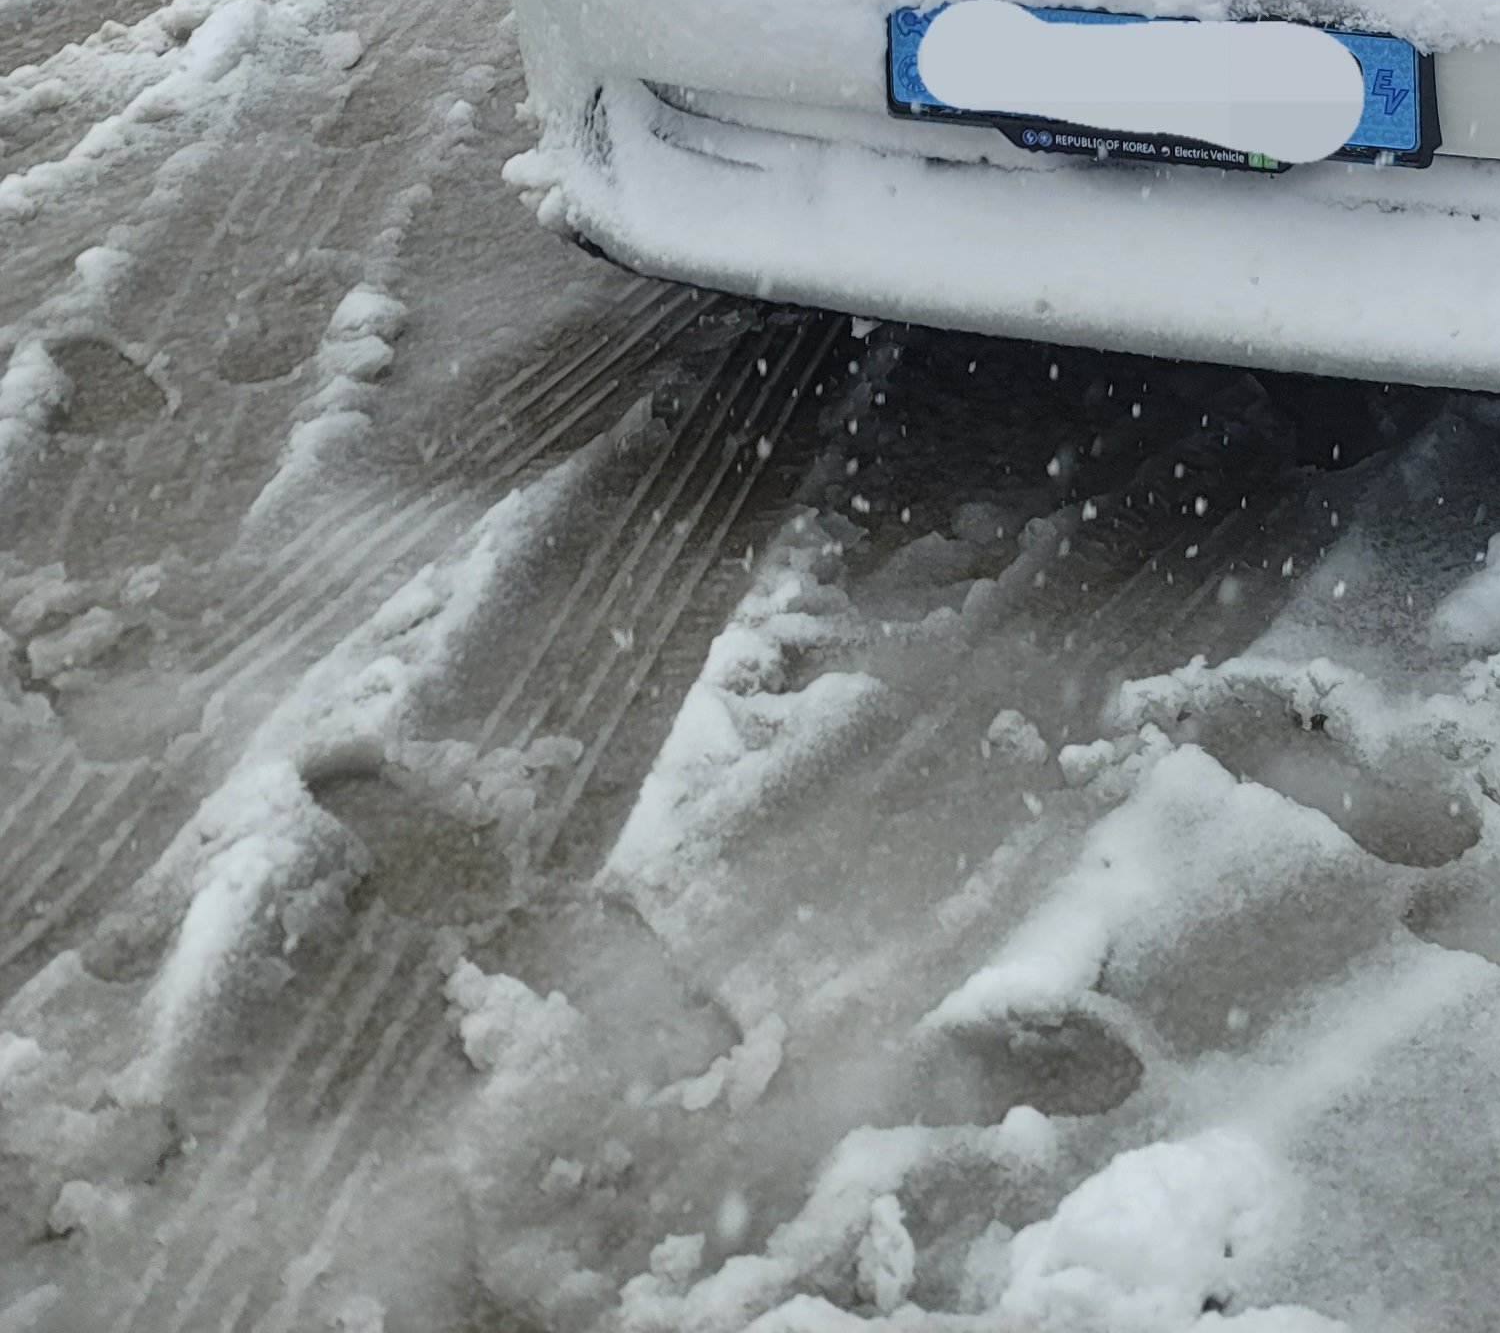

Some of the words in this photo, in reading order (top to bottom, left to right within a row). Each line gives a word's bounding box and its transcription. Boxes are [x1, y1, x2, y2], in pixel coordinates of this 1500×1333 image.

[1372, 69, 1409, 115] EV
[1055, 134, 1105, 150] REPUBLIC
[1106, 139, 1120, 151] OF
[1122, 141, 1156, 155] KOREA
[1174, 146, 1209, 161] Electric
[1209, 149, 1245, 164] Vehicle
